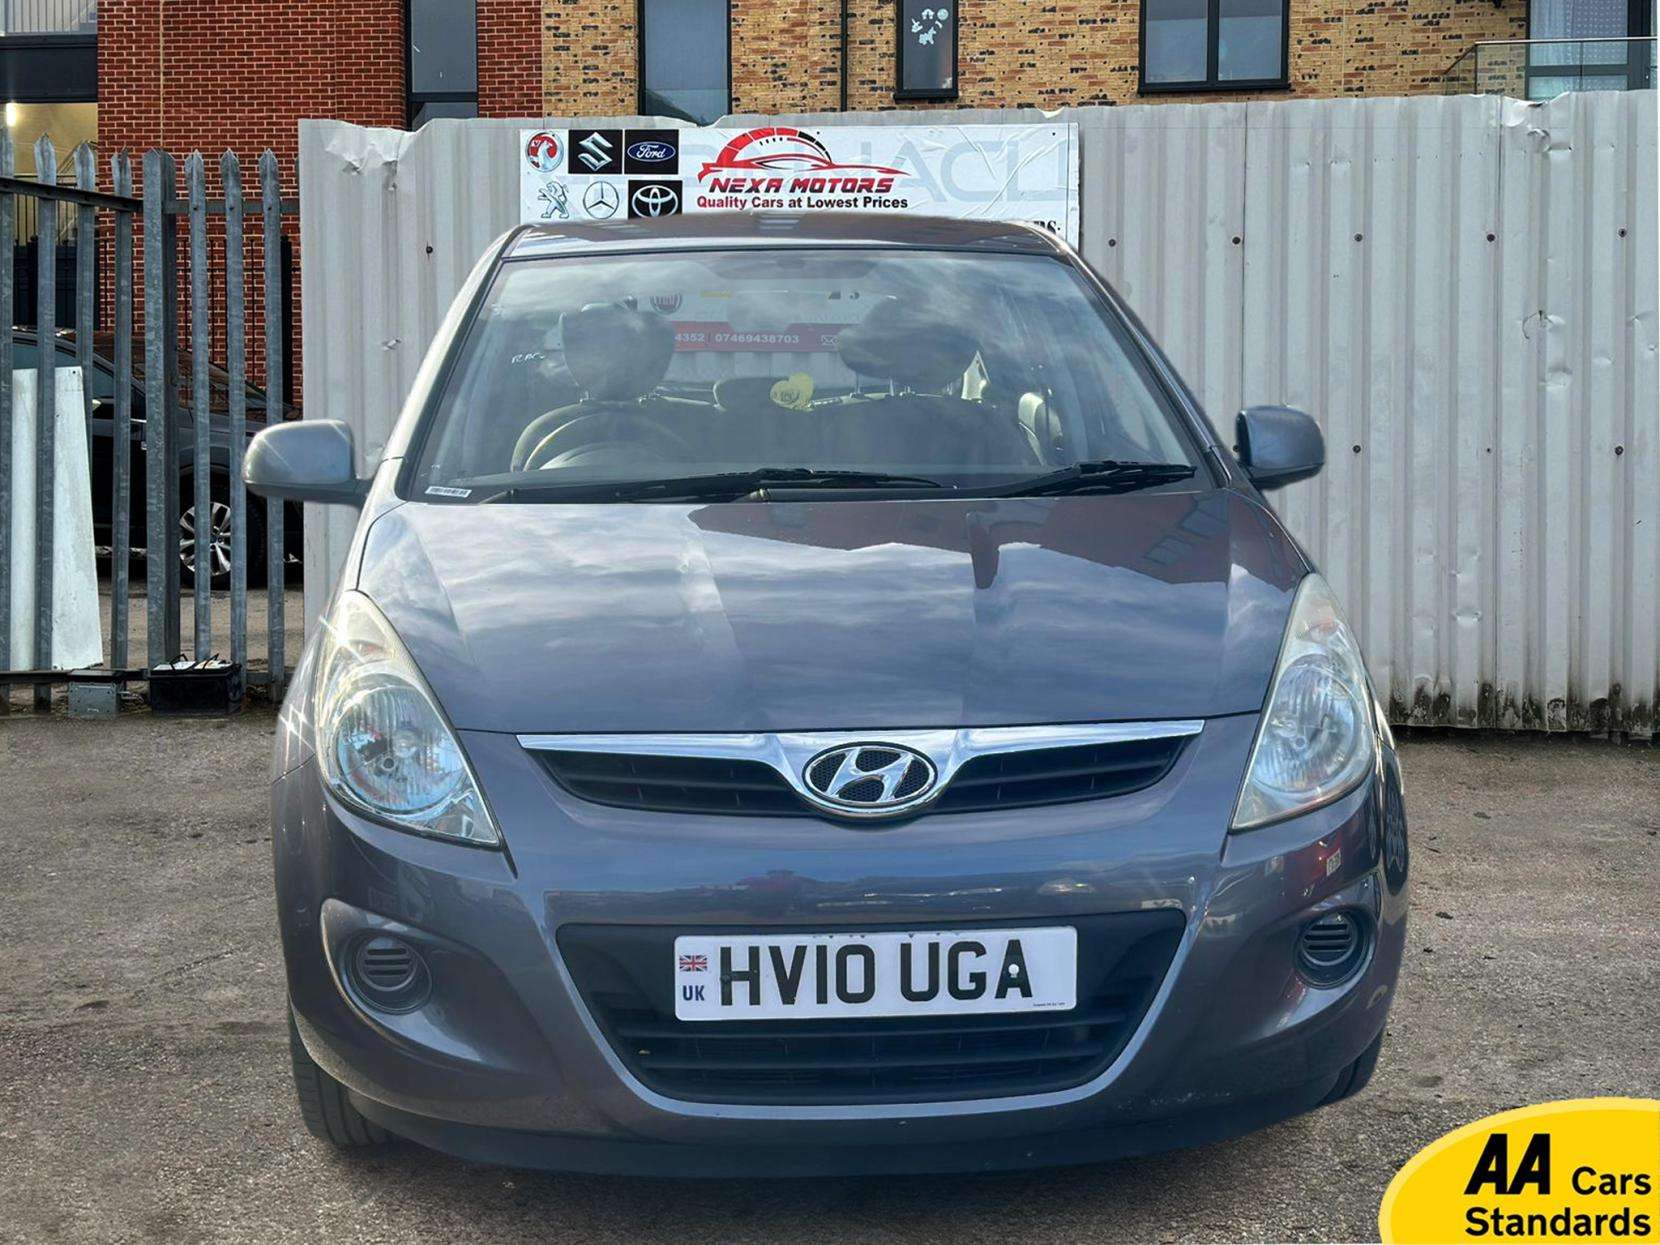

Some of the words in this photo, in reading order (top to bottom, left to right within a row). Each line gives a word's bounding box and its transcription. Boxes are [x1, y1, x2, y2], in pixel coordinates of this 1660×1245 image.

[635, 144, 666, 159] Ford
[709, 177, 783, 193] NEXA
[789, 177, 894, 193] MOTORS
[697, 196, 746, 210] Quality
[751, 195, 784, 208] Cars
[788, 196, 803, 208] at
[807, 196, 859, 208] Lowest
[863, 196, 908, 208] Prices
[719, 944, 875, 1006] HV10
[900, 939, 1033, 1002] UGA
[682, 985, 705, 1001] UK
